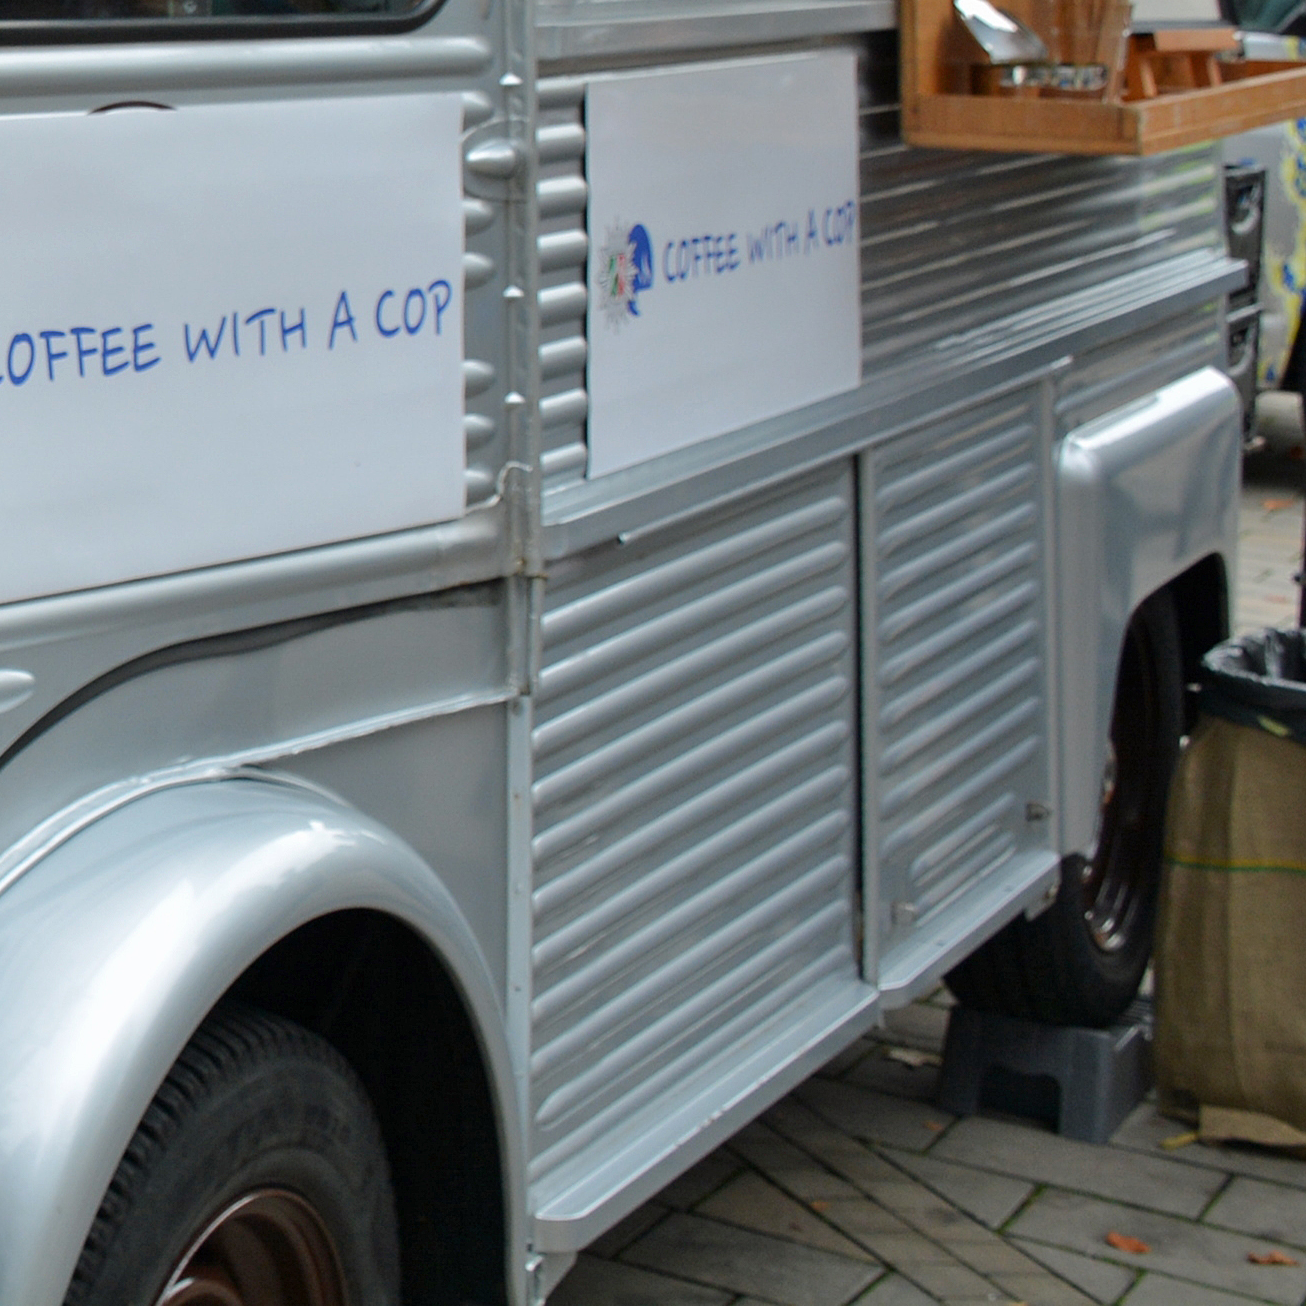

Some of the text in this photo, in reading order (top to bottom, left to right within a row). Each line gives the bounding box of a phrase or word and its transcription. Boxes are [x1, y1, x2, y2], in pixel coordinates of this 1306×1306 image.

[663, 199, 855, 287] COFFEE WITH A COP
[183, 307, 309, 366] WITH
[328, 290, 359, 352] A
[375, 277, 454, 339] COP
